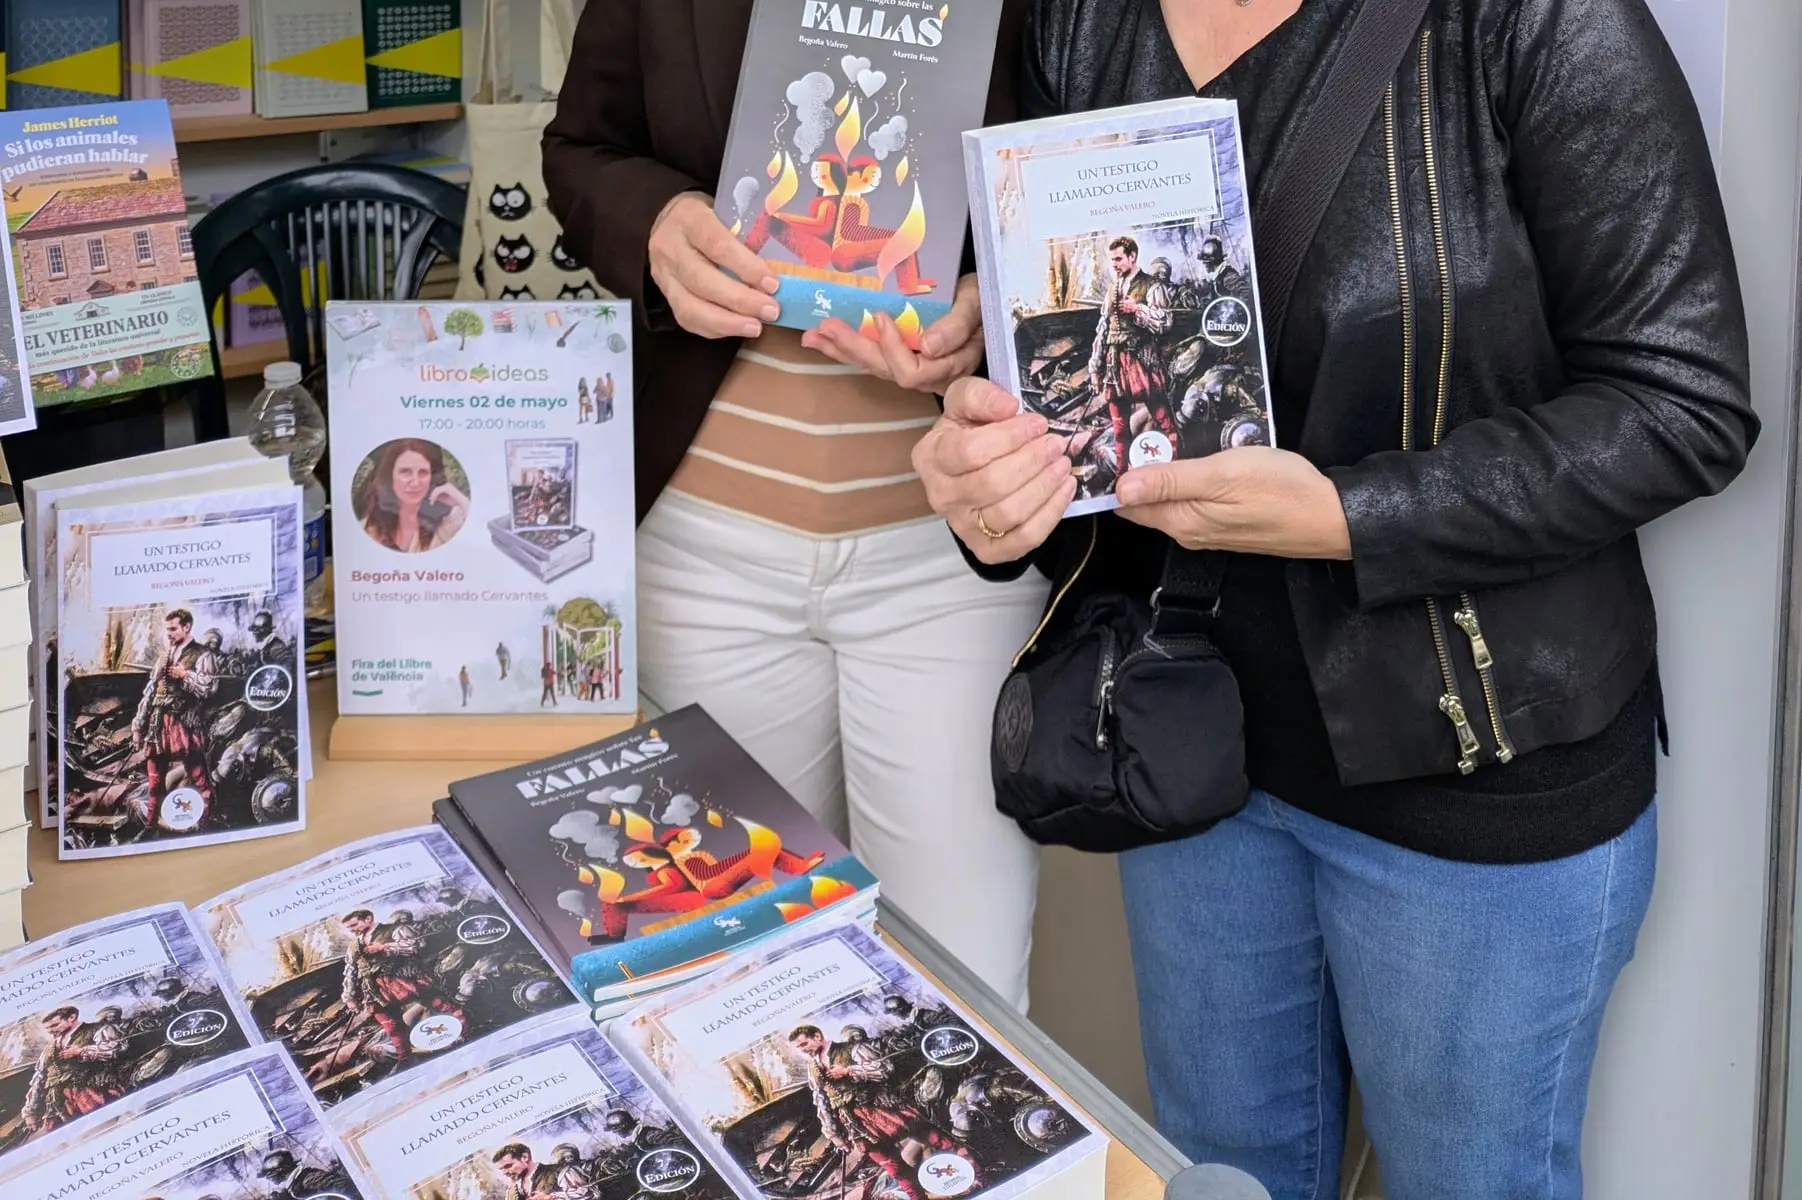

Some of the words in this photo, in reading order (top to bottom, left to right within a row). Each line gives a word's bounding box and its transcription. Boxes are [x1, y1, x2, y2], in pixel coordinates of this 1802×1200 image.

[921, 1, 934, 11] las
[801, 0, 944, 48] FALLAS
[798, 34, 825, 47] Begoña
[825, 38, 849, 50] Valero
[892, 49, 919, 62] Martín
[918, 53, 940, 64] Forés
[22, 121, 67, 133] James
[68, 114, 119, 129] Herriot
[4, 140, 25, 158] Si
[24, 137, 54, 153] los
[55, 130, 139, 149] animales
[1, 153, 86, 184] pudieran
[89, 148, 149, 165] hablar
[1077, 167, 1098, 181] UN
[1099, 159, 1159, 177] TESTIGO
[1049, 185, 1114, 204] LLAMADO
[1116, 173, 1192, 194] CERVANTES
[1090, 205, 1121, 217] BEGOÑA
[1121, 200, 1156, 212] VALERO
[24, 334, 45, 351] EL
[45, 310, 169, 346] VETERINARIO
[1206, 319, 1246, 332] EDICIÓN
[419, 365, 468, 382] libro
[491, 364, 549, 382] ideas
[400, 394, 465, 409] Viernes
[469, 396, 490, 408] 02
[495, 395, 516, 408] de
[520, 397, 568, 411] mayo
[419, 419, 454, 430] 17:00
[465, 418, 504, 430] 20:00
[507, 418, 546, 430] horas
[143, 546, 167, 557] UN
[168, 539, 222, 555] TESTIGO
[114, 560, 178, 577] LLAMADO
[179, 553, 251, 571] CERVANTES
[184, 577, 215, 588] VALERO
[351, 570, 410, 584] Begoña
[414, 570, 465, 582] Valero
[352, 591, 371, 602] Un
[374, 590, 421, 604] testigo
[424, 590, 479, 602] llamado
[481, 590, 549, 602] Cervantes
[351, 658, 374, 669] Fira
[376, 658, 396, 669] del
[399, 659, 432, 669] Llibre
[352, 671, 368, 682] de
[249, 685, 287, 698] EDICIÓN
[516, 738, 670, 800] FALLAS
[268, 888, 337, 919] LLAMADO
[337, 860, 413, 892] CERVANTES
[295, 884, 318, 897] UN
[317, 861, 377, 889] TESTIGO
[463, 926, 506, 939] EDICIÓN
[1, 975, 25, 992] UN
[26, 949, 96, 980] TESTIGO
[47, 946, 136, 983] CERVANTES
[58, 974, 96, 992] VALERO
[722, 991, 746, 1010] UN
[744, 965, 802, 999] TESTIGO
[702, 998, 768, 1036] LLAMADO
[769, 962, 842, 1002] CERVANTES
[172, 1022, 222, 1039] EDICIÓN
[928, 1040, 975, 1060] EDICIÓN
[429, 1103, 457, 1123] UN
[457, 1075, 524, 1111] TESTIGO
[401, 1111, 480, 1157] LLAMADO
[481, 1072, 568, 1115] CERVANTES
[498, 1104, 534, 1127] VALERO
[534, 1101, 565, 1121] NOVELA
[37, 1161, 121, 1200] AMADO
[123, 1109, 232, 1166] CERVANTES
[65, 1156, 95, 1177] UN
[97, 1115, 182, 1160] TESTIGO
[181, 1146, 220, 1168] NOVELA
[219, 1124, 272, 1152] HISTÓRICA
[138, 1150, 184, 1177] VALERO
[644, 1164, 695, 1186] EDICIÓN
